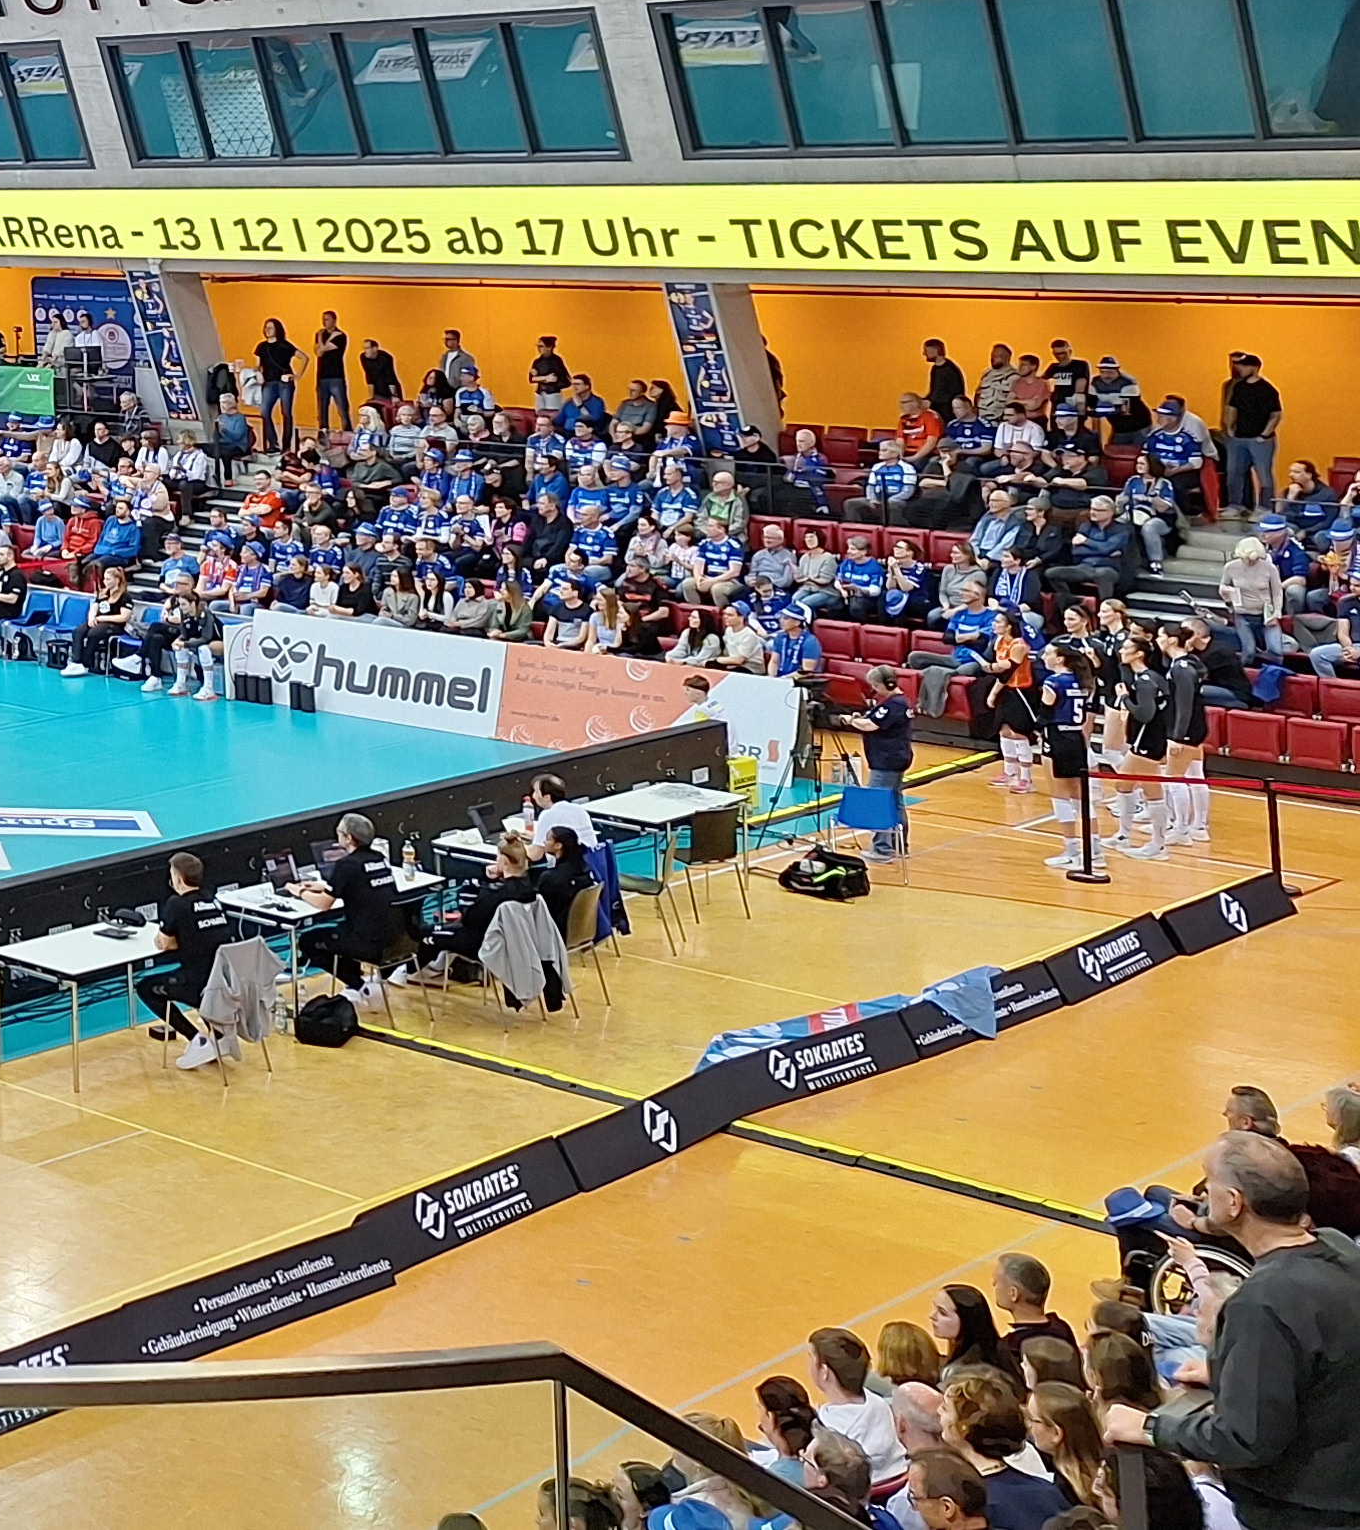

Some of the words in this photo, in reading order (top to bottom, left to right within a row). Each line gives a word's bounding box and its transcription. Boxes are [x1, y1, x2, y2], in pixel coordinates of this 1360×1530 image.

[153, 217, 200, 251] 13
[238, 217, 281, 252] 12
[316, 218, 431, 253] 2025
[446, 217, 504, 255] ab
[518, 219, 566, 255] 17
[584, 217, 680, 258] Uhr
[728, 218, 990, 263] TICKETS
[1010, 219, 1143, 264] AUF
[313, 642, 492, 714] hummel
[1072, 698, 1084, 723] 5
[1094, 931, 1140, 965] SOKRATES
[794, 1032, 865, 1070] SOKRATES
[807, 1063, 878, 1090] MULTISERVICES
[442, 1166, 519, 1215] SOKRATES
[456, 1196, 534, 1240] MULTISERVICES
[147, 1314, 237, 1357] Gebäudereinigung
[238, 1289, 303, 1324] Winterdienste
[307, 1255, 392, 1299] Hausmeisterdienste
[199, 1275, 273, 1316] Personaldienste
[276, 1252, 336, 1286] Eventdienste
